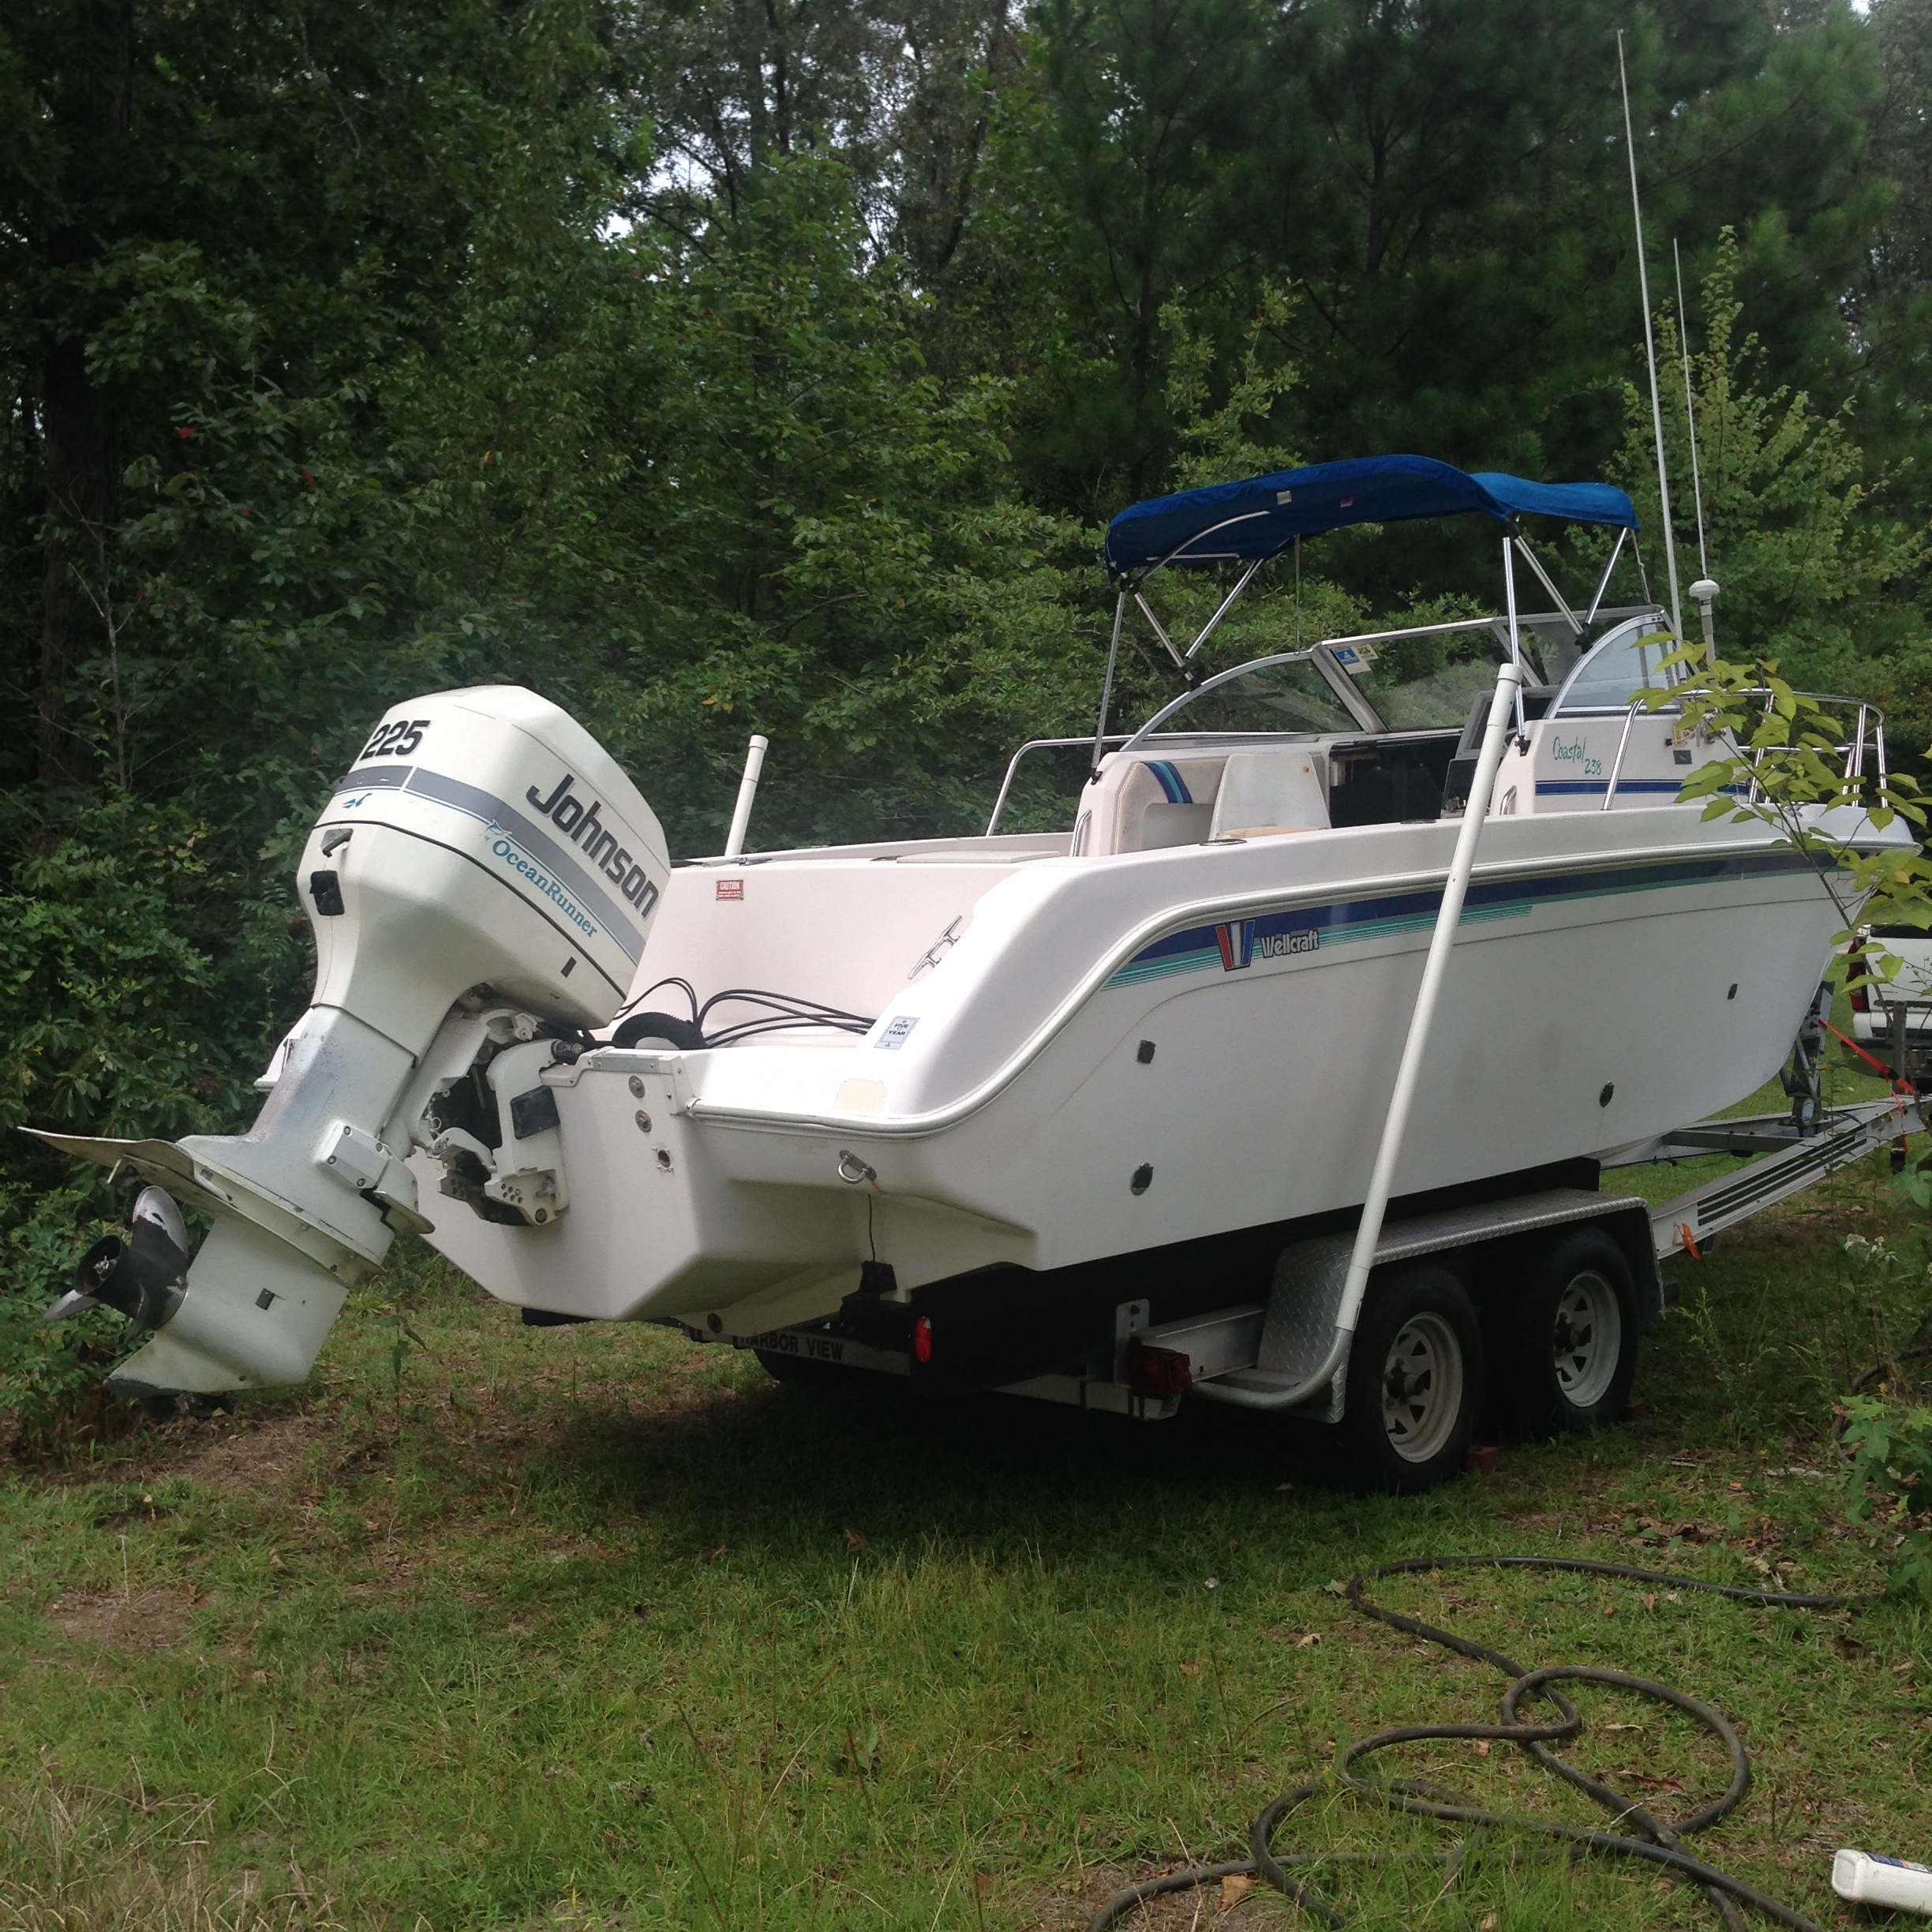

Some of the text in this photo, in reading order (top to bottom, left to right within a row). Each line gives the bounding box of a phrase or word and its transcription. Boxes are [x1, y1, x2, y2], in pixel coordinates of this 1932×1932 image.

[359, 720, 431, 761] 225
[1552, 736, 1586, 763] Coastal
[1585, 758, 1601, 775] 238
[526, 773, 659, 918] Johnson
[492, 840, 597, 937] OceanRunner
[1261, 928, 1320, 958] Wellcraft
[806, 1337, 844, 1361] VIEW
